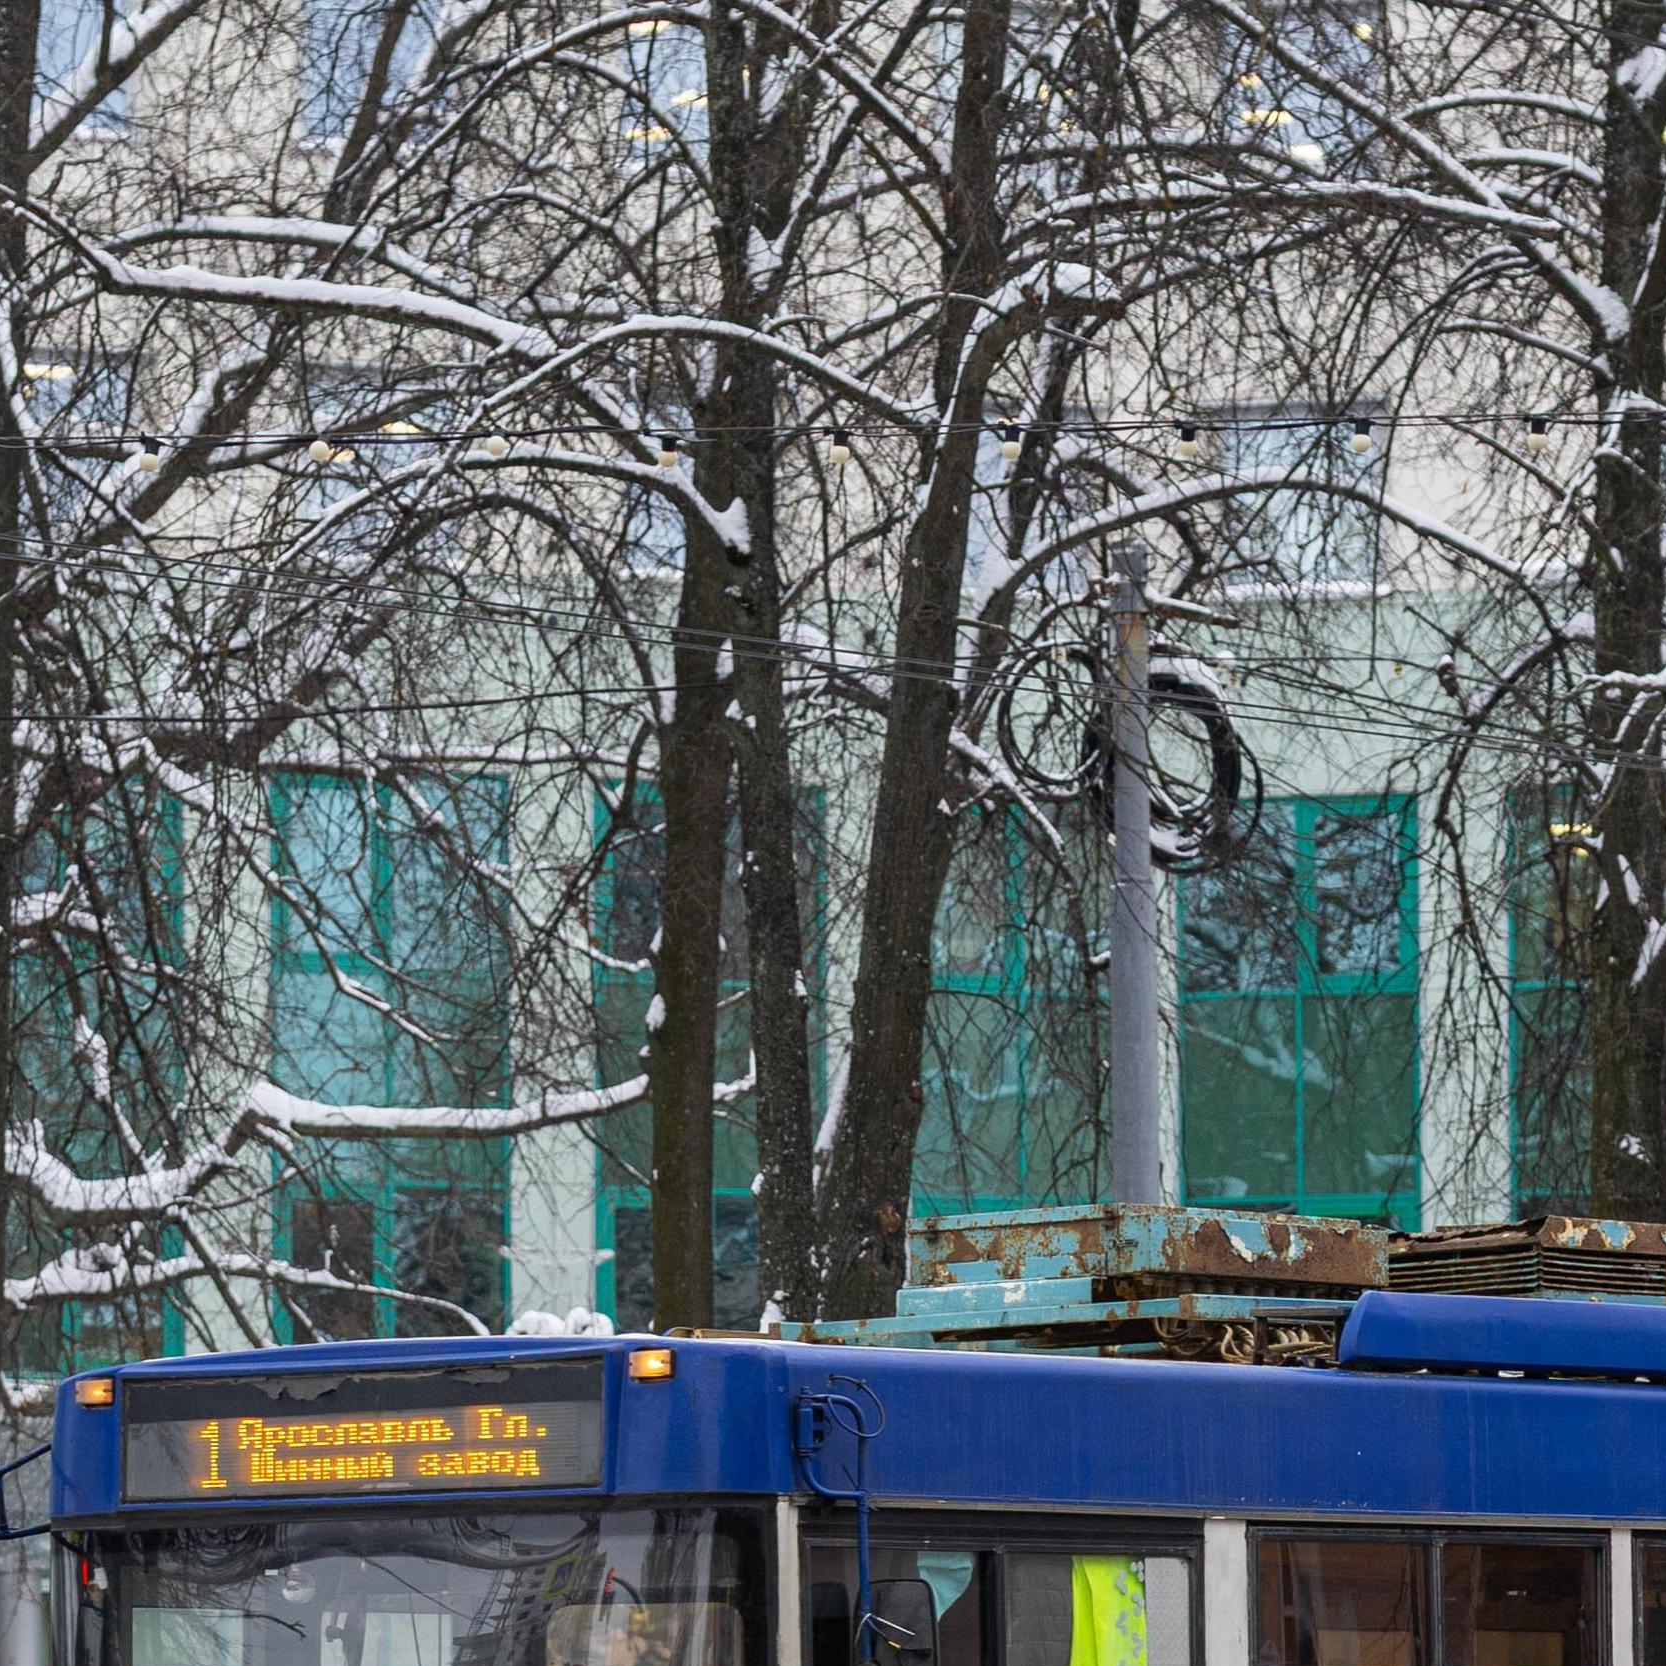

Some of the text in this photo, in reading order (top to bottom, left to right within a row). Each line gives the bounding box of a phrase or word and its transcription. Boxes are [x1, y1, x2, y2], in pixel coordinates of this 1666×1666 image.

[237, 1406, 549, 1450] Ярославль Гл.
[200, 1421, 227, 1488] 1
[250, 1449, 541, 1483] Шинный завод
